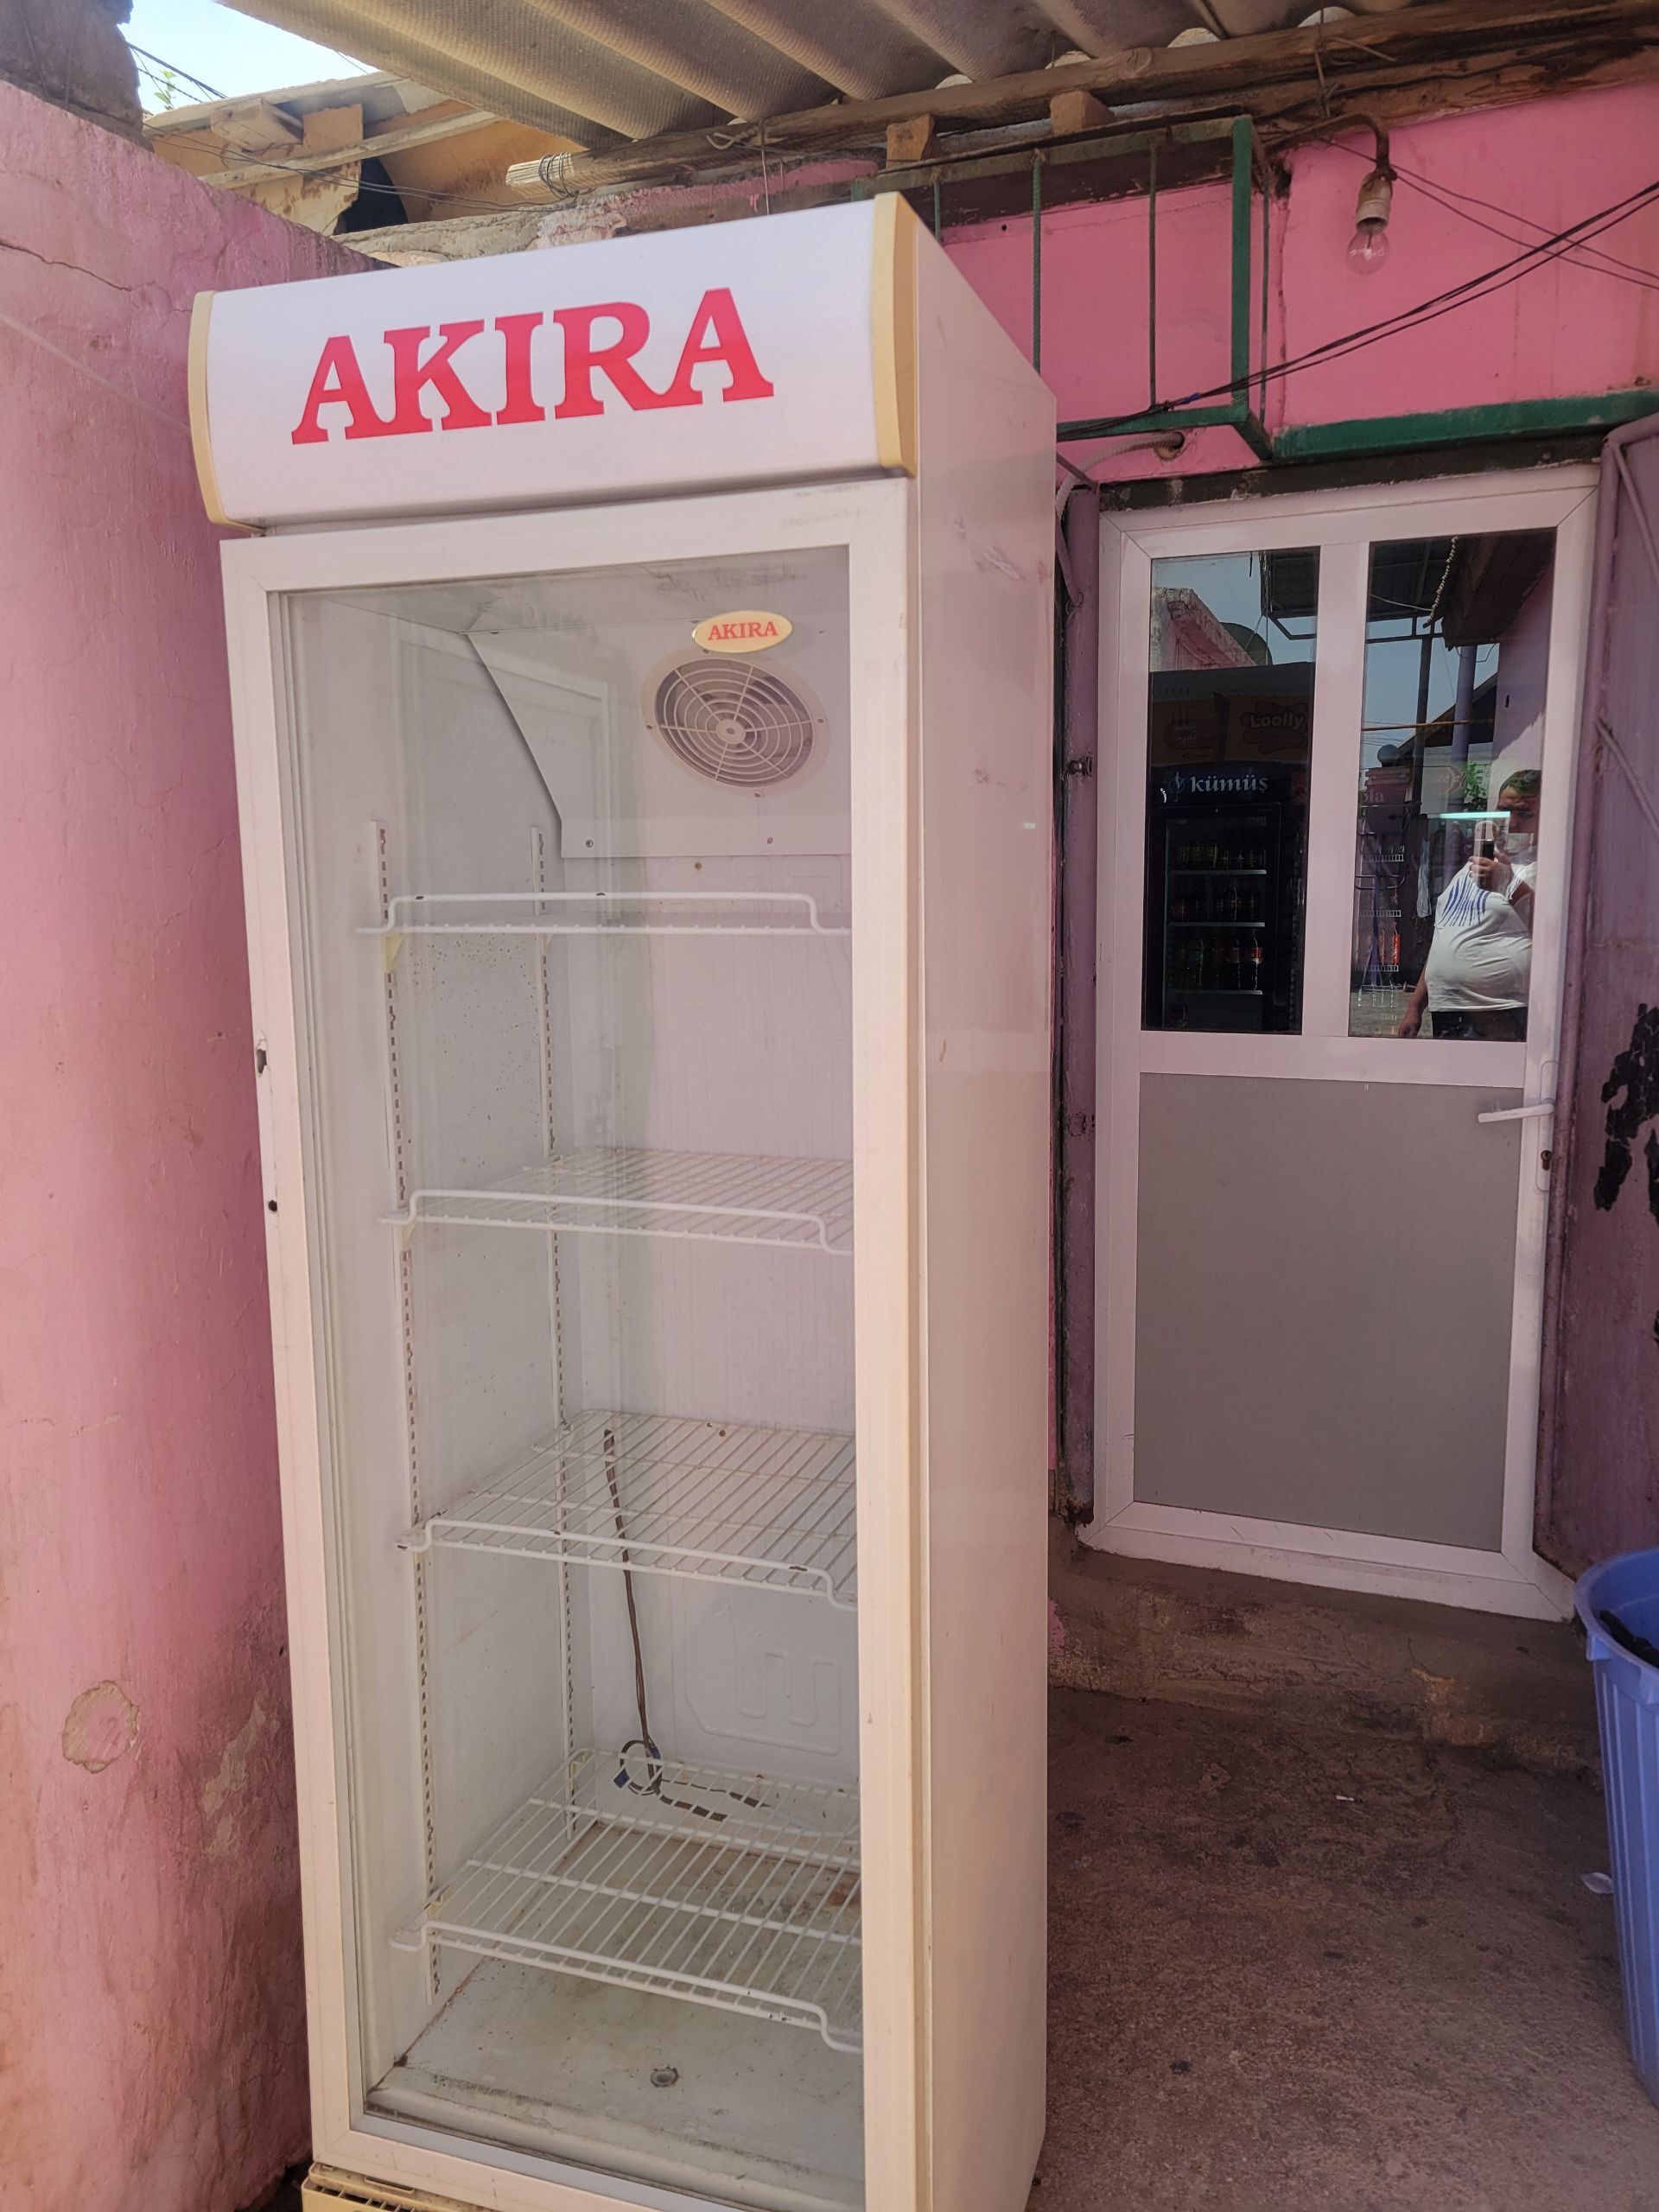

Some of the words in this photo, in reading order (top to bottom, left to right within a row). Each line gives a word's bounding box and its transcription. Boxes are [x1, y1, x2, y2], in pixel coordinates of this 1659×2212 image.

[291, 287, 774, 445] AKIRA
[708, 621, 779, 641] AKIRA
[1249, 712, 1304, 730] Loolly
[1191, 774, 1269, 794] kümüş
